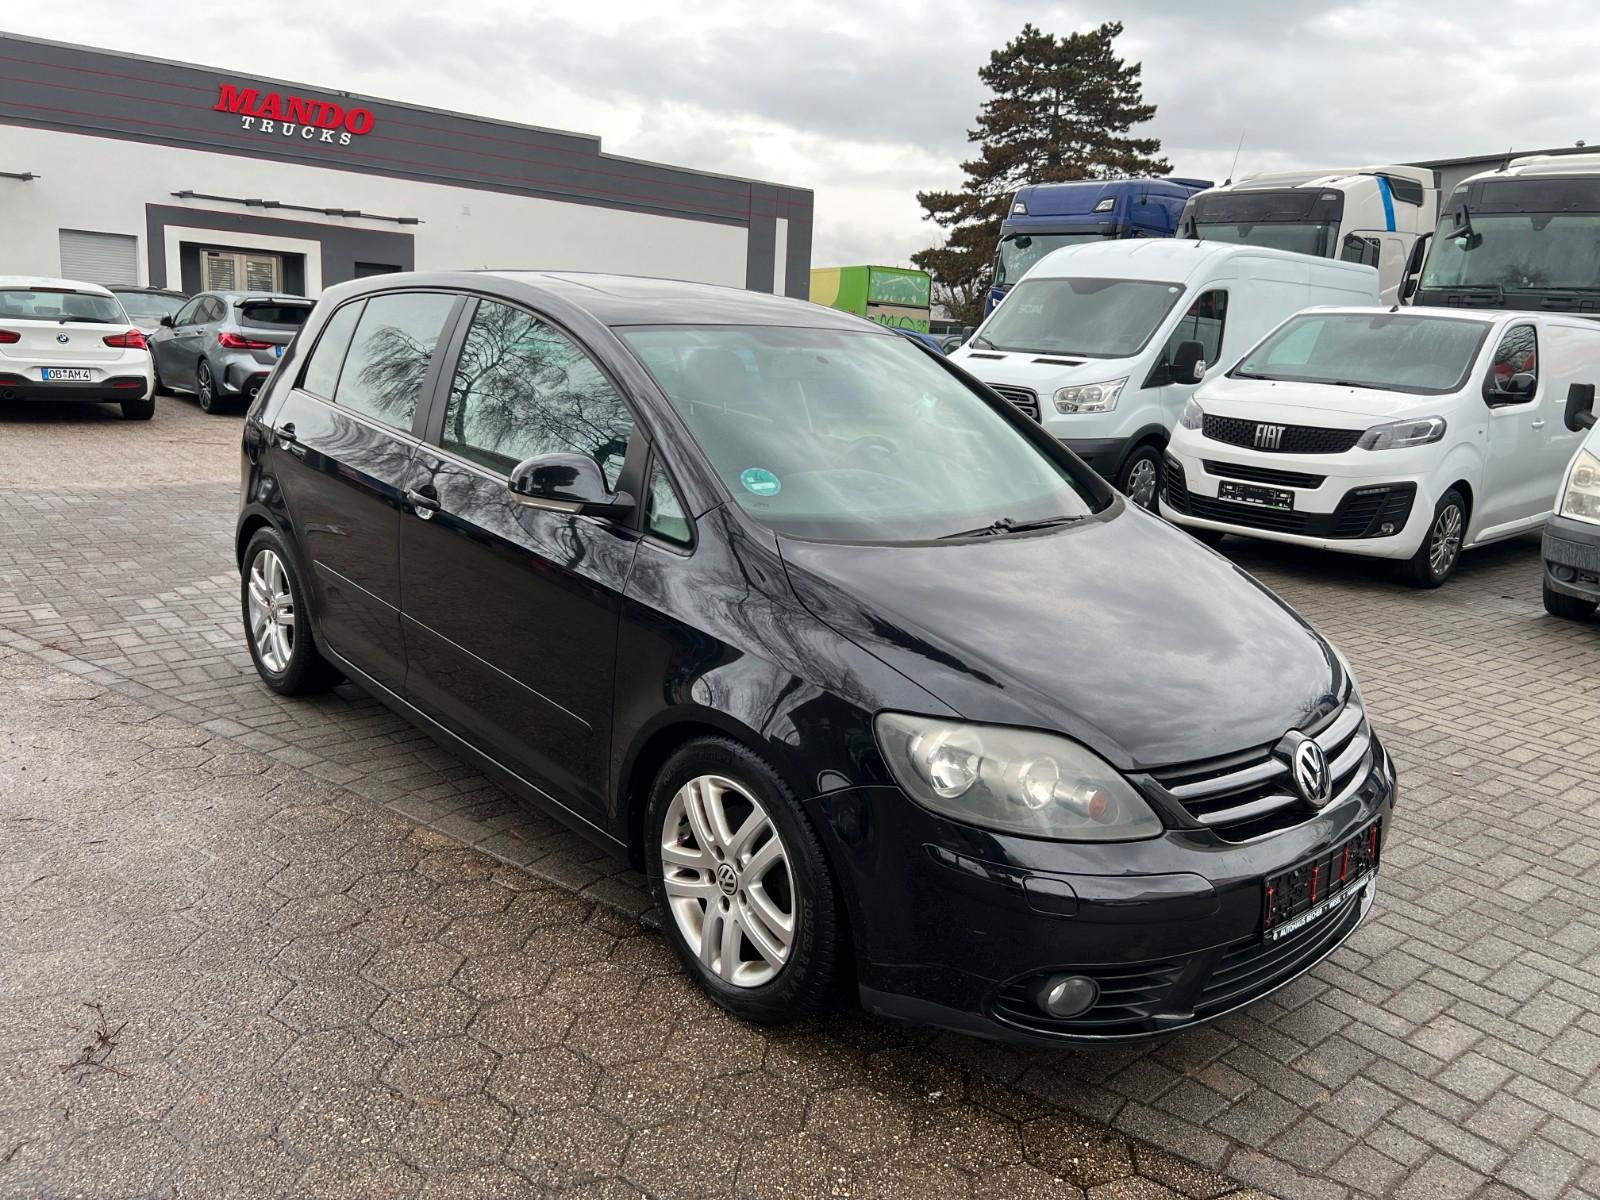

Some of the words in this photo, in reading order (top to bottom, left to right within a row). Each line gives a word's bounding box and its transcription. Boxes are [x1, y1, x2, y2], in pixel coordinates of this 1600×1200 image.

[213, 83, 376, 135] MANDO
[241, 116, 351, 145] TRUCKS
[48, 370, 62, 379] OB
[68, 370, 81, 379] AM
[83, 370, 89, 379] 4
[1254, 424, 1286, 449] FIAT
